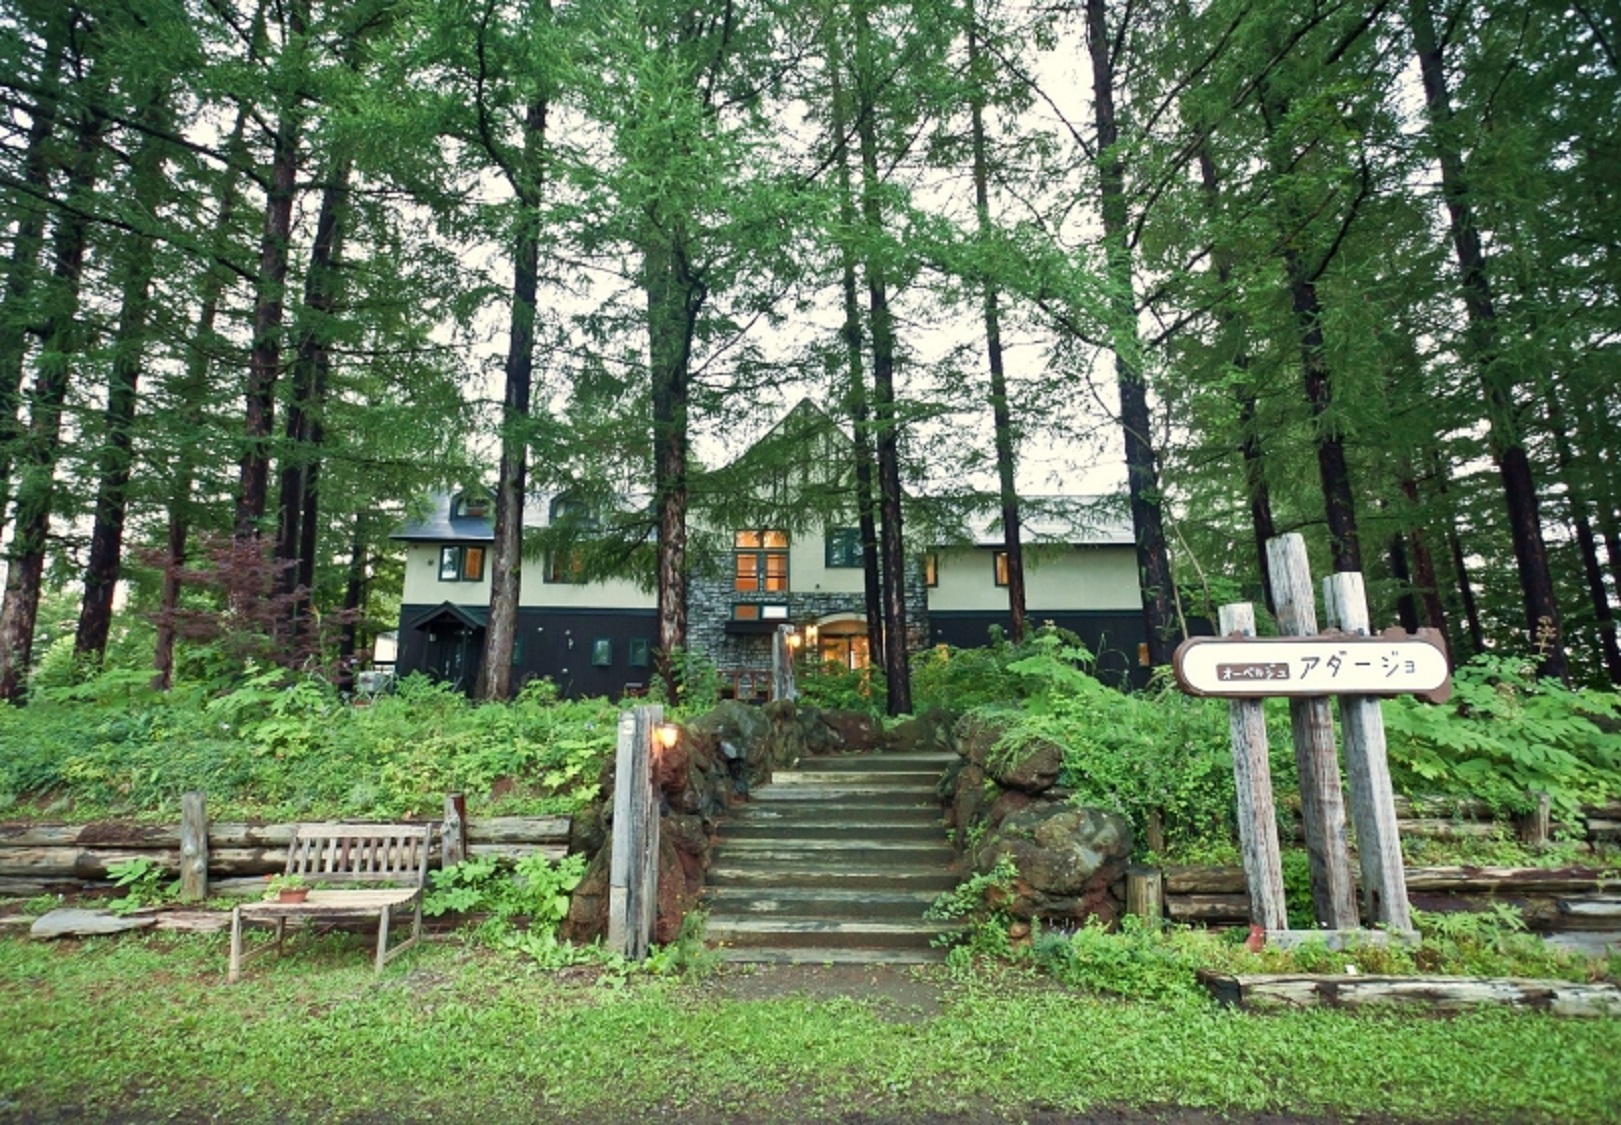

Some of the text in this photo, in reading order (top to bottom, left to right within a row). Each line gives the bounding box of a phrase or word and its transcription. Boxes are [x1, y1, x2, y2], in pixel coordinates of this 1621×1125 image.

[1222, 650, 1416, 680] オーベルジュ アダージョ
